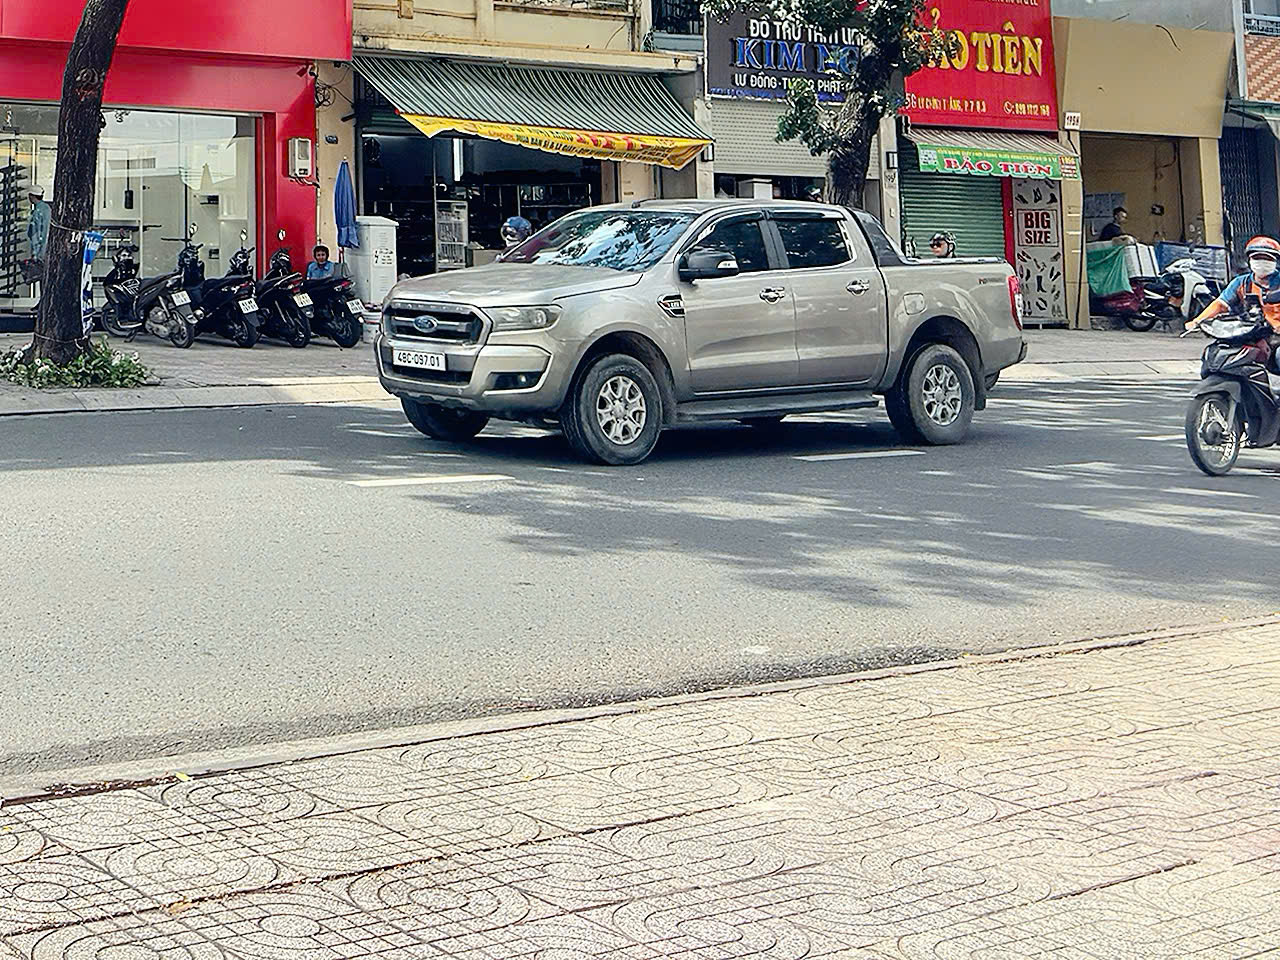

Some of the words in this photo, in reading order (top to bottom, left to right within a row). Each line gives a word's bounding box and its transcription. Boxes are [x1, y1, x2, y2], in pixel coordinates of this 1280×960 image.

[736, 37, 807, 72] KIM
[971, 21, 1042, 77] TIÊN
[999, 159, 1052, 176] TIÊN
[1024, 212, 1051, 229] BIG
[1025, 230, 1051, 244] SIZE
